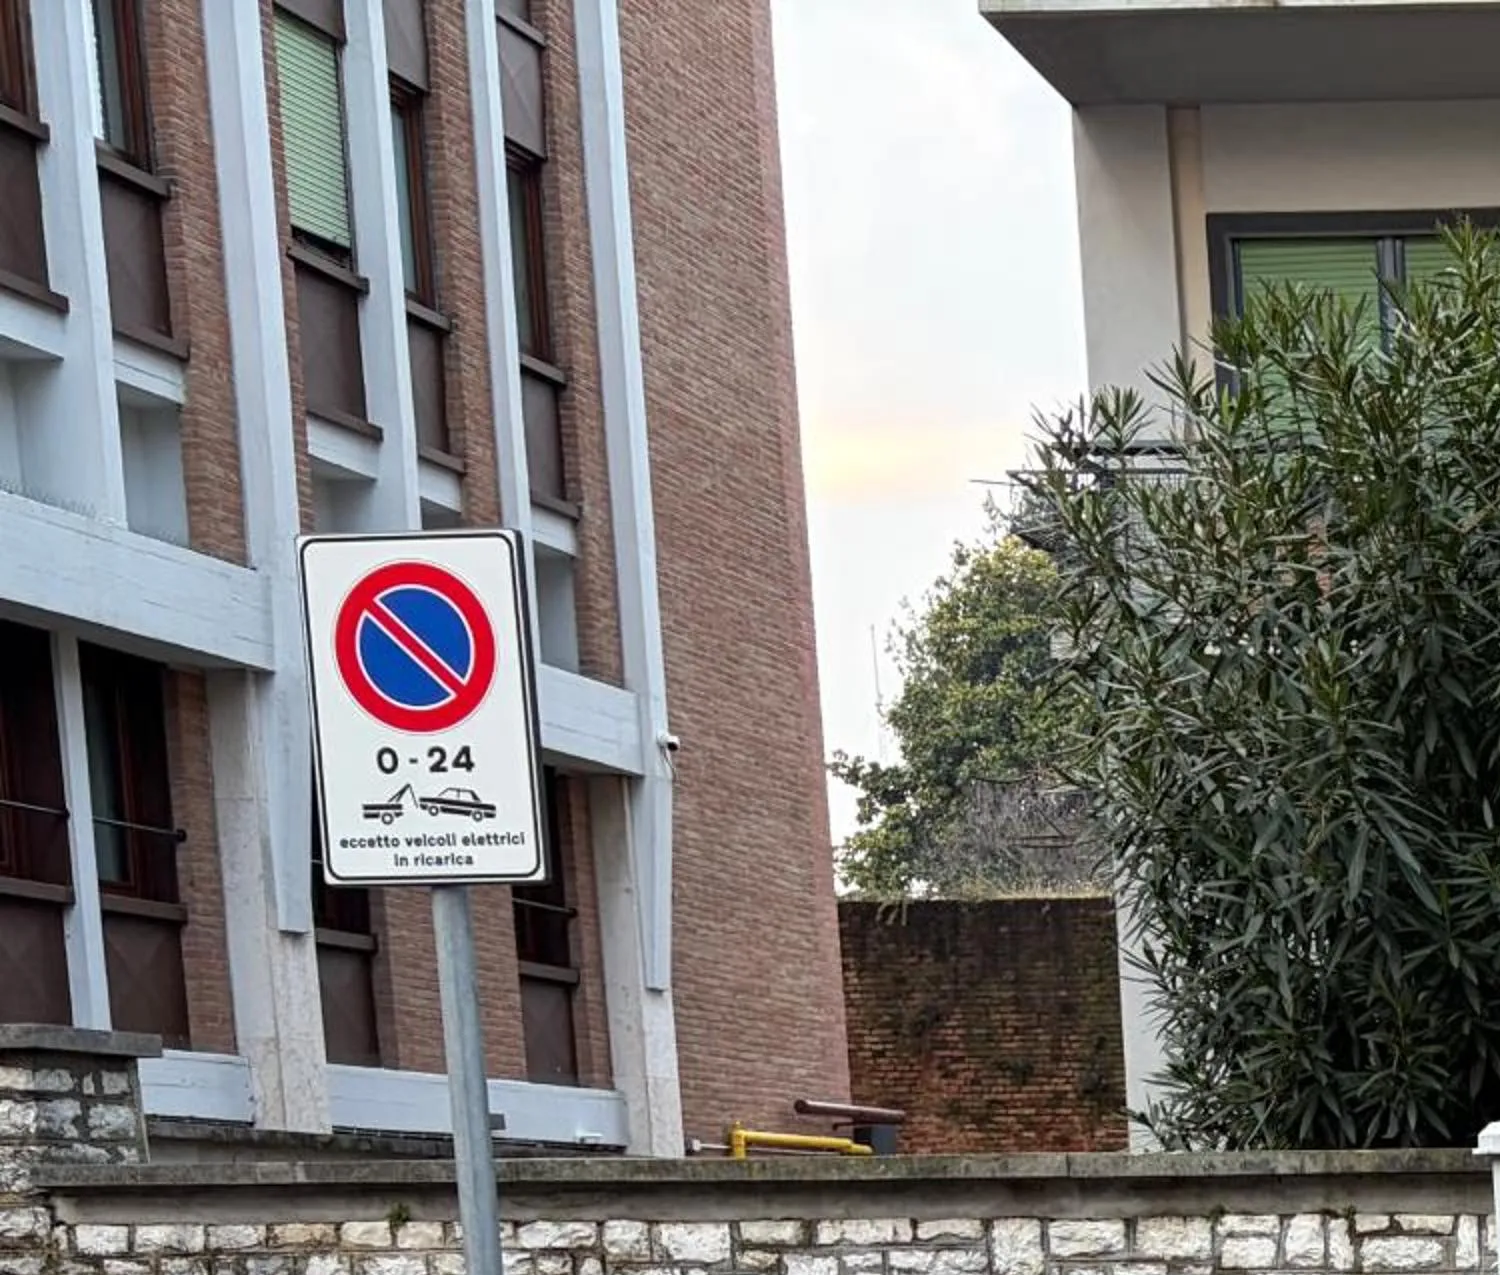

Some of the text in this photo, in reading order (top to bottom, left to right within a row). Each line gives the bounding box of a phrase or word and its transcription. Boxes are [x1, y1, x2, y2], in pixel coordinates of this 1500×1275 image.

[376, 747, 399, 774] 0
[427, 746, 475, 773] 24
[339, 831, 526, 849] eccetto veicoli elettrici
[394, 853, 474, 867] in ricarica
